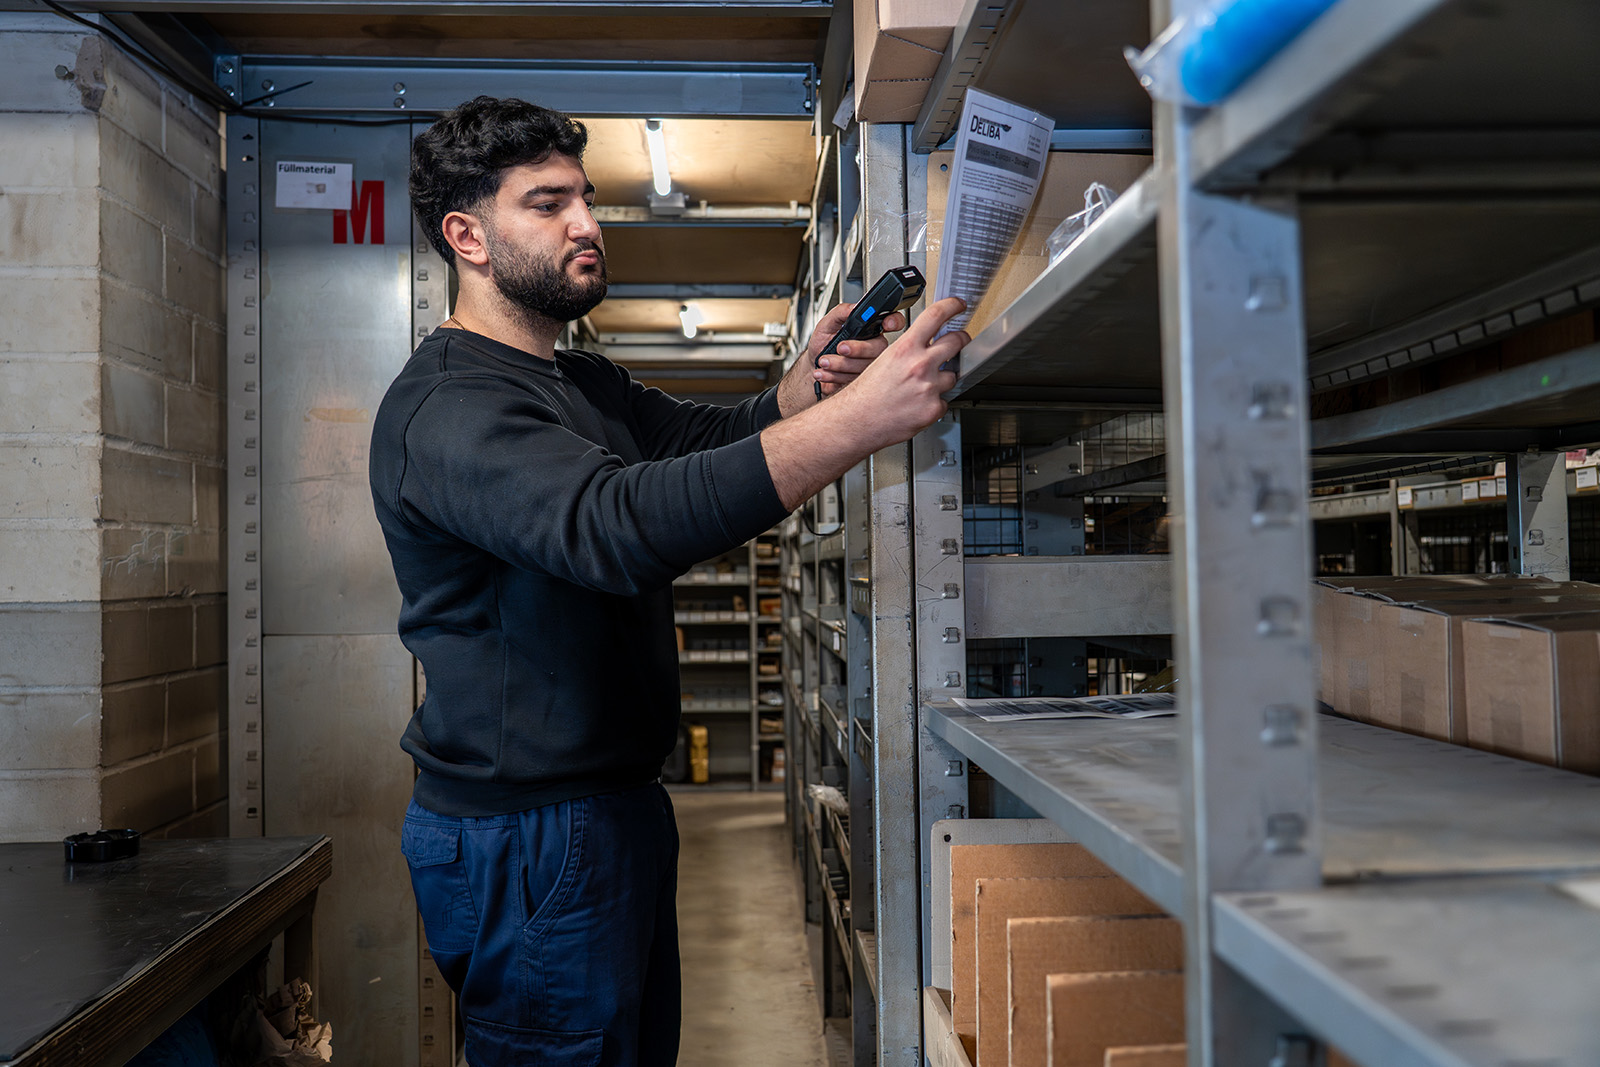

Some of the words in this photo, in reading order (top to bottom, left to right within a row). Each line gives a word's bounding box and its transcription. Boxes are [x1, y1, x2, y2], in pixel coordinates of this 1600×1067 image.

[970, 115, 1001, 141] DELIBA
[278, 163, 336, 174] Füllmaterial
[333, 180, 385, 245] M
